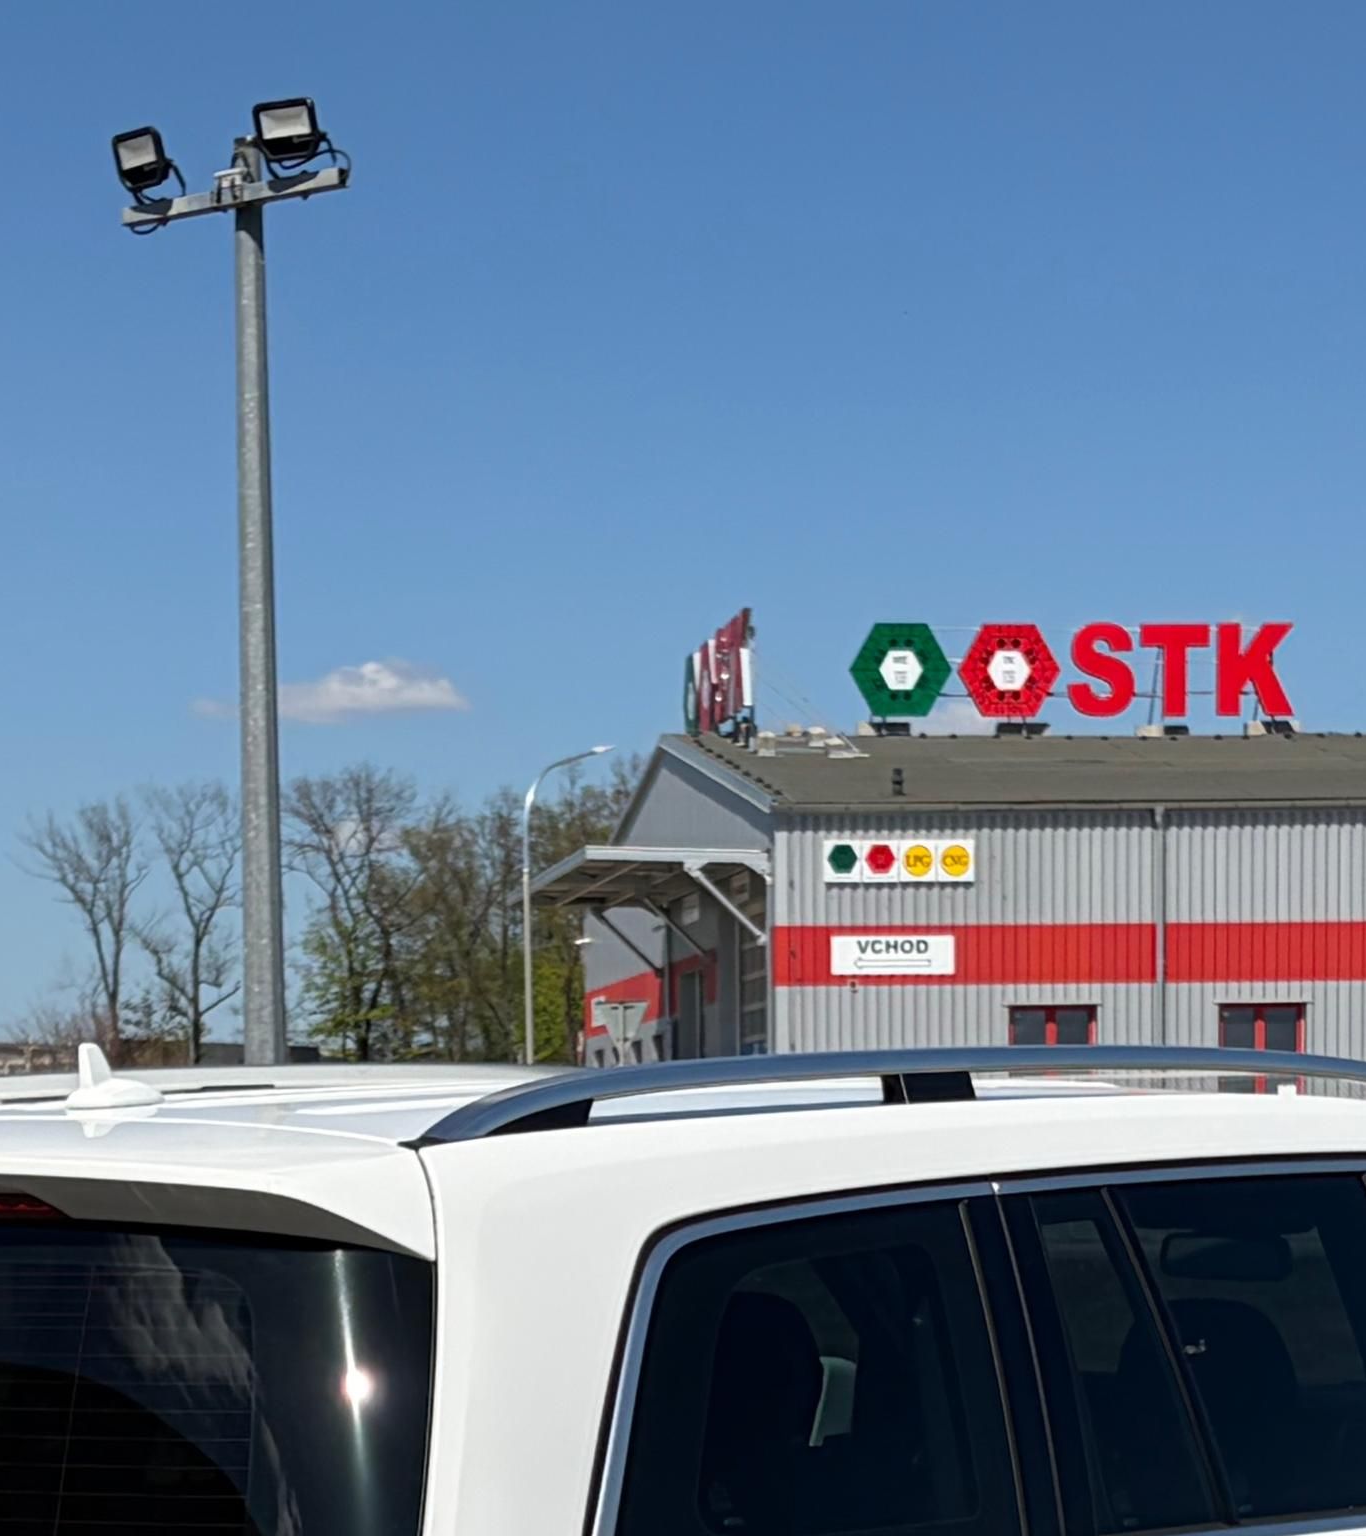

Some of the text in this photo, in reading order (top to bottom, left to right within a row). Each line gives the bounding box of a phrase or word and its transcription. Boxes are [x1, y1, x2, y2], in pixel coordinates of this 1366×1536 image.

[1067, 621, 1295, 717] STK
[905, 853, 933, 868] LPG
[857, 939, 929, 955] VCHOD
